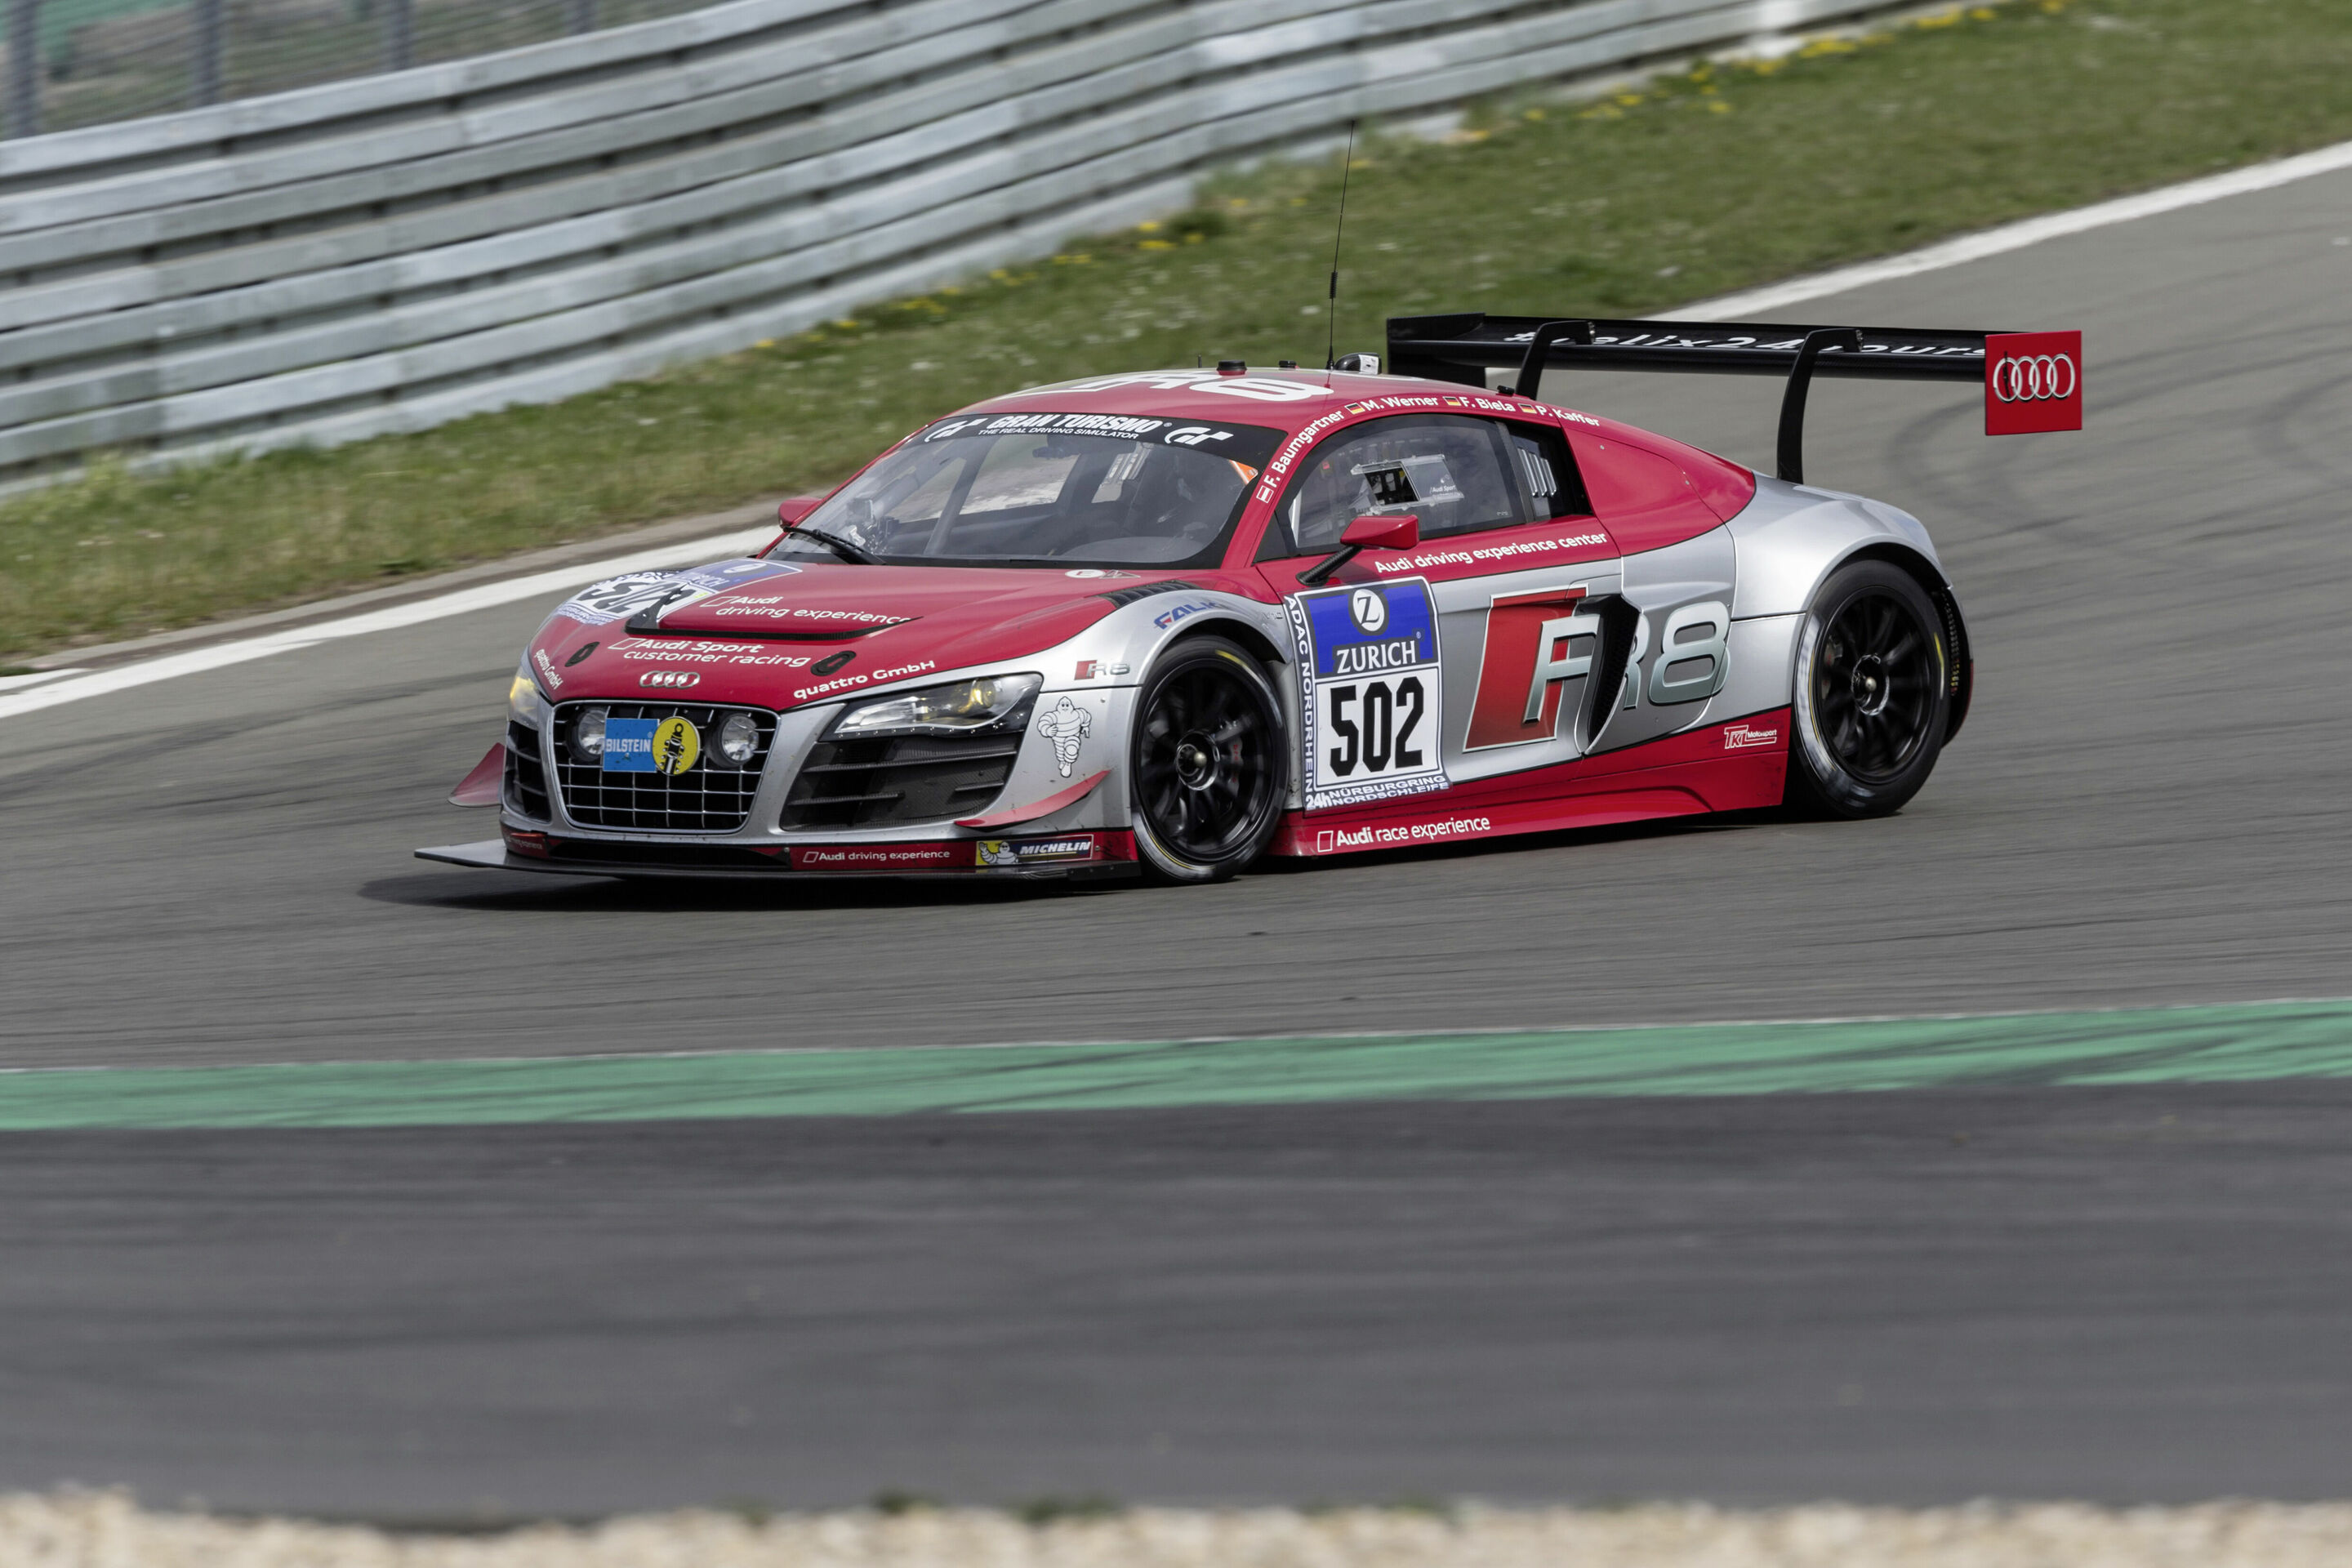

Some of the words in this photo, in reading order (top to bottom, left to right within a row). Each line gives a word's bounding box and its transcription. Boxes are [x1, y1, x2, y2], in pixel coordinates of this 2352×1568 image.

[1361, 399, 1384, 411] M.
[1388, 396, 1438, 408] Werner
[1459, 396, 1476, 408] F.
[1477, 398, 1516, 412] Biela
[987, 414, 1062, 429] GRAN
[1054, 414, 1163, 433] TURISMO
[1535, 405, 1553, 416] P.
[1556, 408, 1601, 427] Kaffer
[1074, 429, 1139, 439] SIMULATOR
[1271, 410, 1344, 474] Baumgartner
[1263, 474, 1281, 488] F.
[1374, 558, 1414, 572] Audi
[1414, 550, 1473, 568] driving
[1473, 537, 1558, 560] experience
[1558, 532, 1608, 548] center
[730, 596, 783, 604] Audi
[715, 607, 791, 618] driving
[635, 639, 692, 650] Audi
[691, 641, 764, 653] Sport
[623, 651, 728, 662] customer
[728, 655, 811, 667] racing
[1336, 640, 1417, 674] ZURICH
[534, 648, 550, 670] quattro
[544, 666, 564, 690] GmbH
[793, 675, 868, 700] quattro
[872, 660, 935, 680] GmbH
[1284, 596, 1308, 655] ADAC
[1301, 662, 1315, 792] NORDRHEIN
[1330, 676, 1424, 777] 502
[1747, 729, 1777, 738] Motorsport
[605, 737, 651, 753] BILSTEIN
[1305, 792, 1332, 810] 24h
[1330, 776, 1446, 798] NÜRBURGRING
[1332, 782, 1450, 806] NORDSCHLEIFE
[1337, 826, 1374, 846] Audi
[1375, 826, 1409, 842] race
[1411, 817, 1490, 840] experience
[819, 852, 844, 861] Audi
[849, 852, 886, 862] driving
[889, 850, 950, 860] experience
[1019, 841, 1091, 854] MICHELIN
